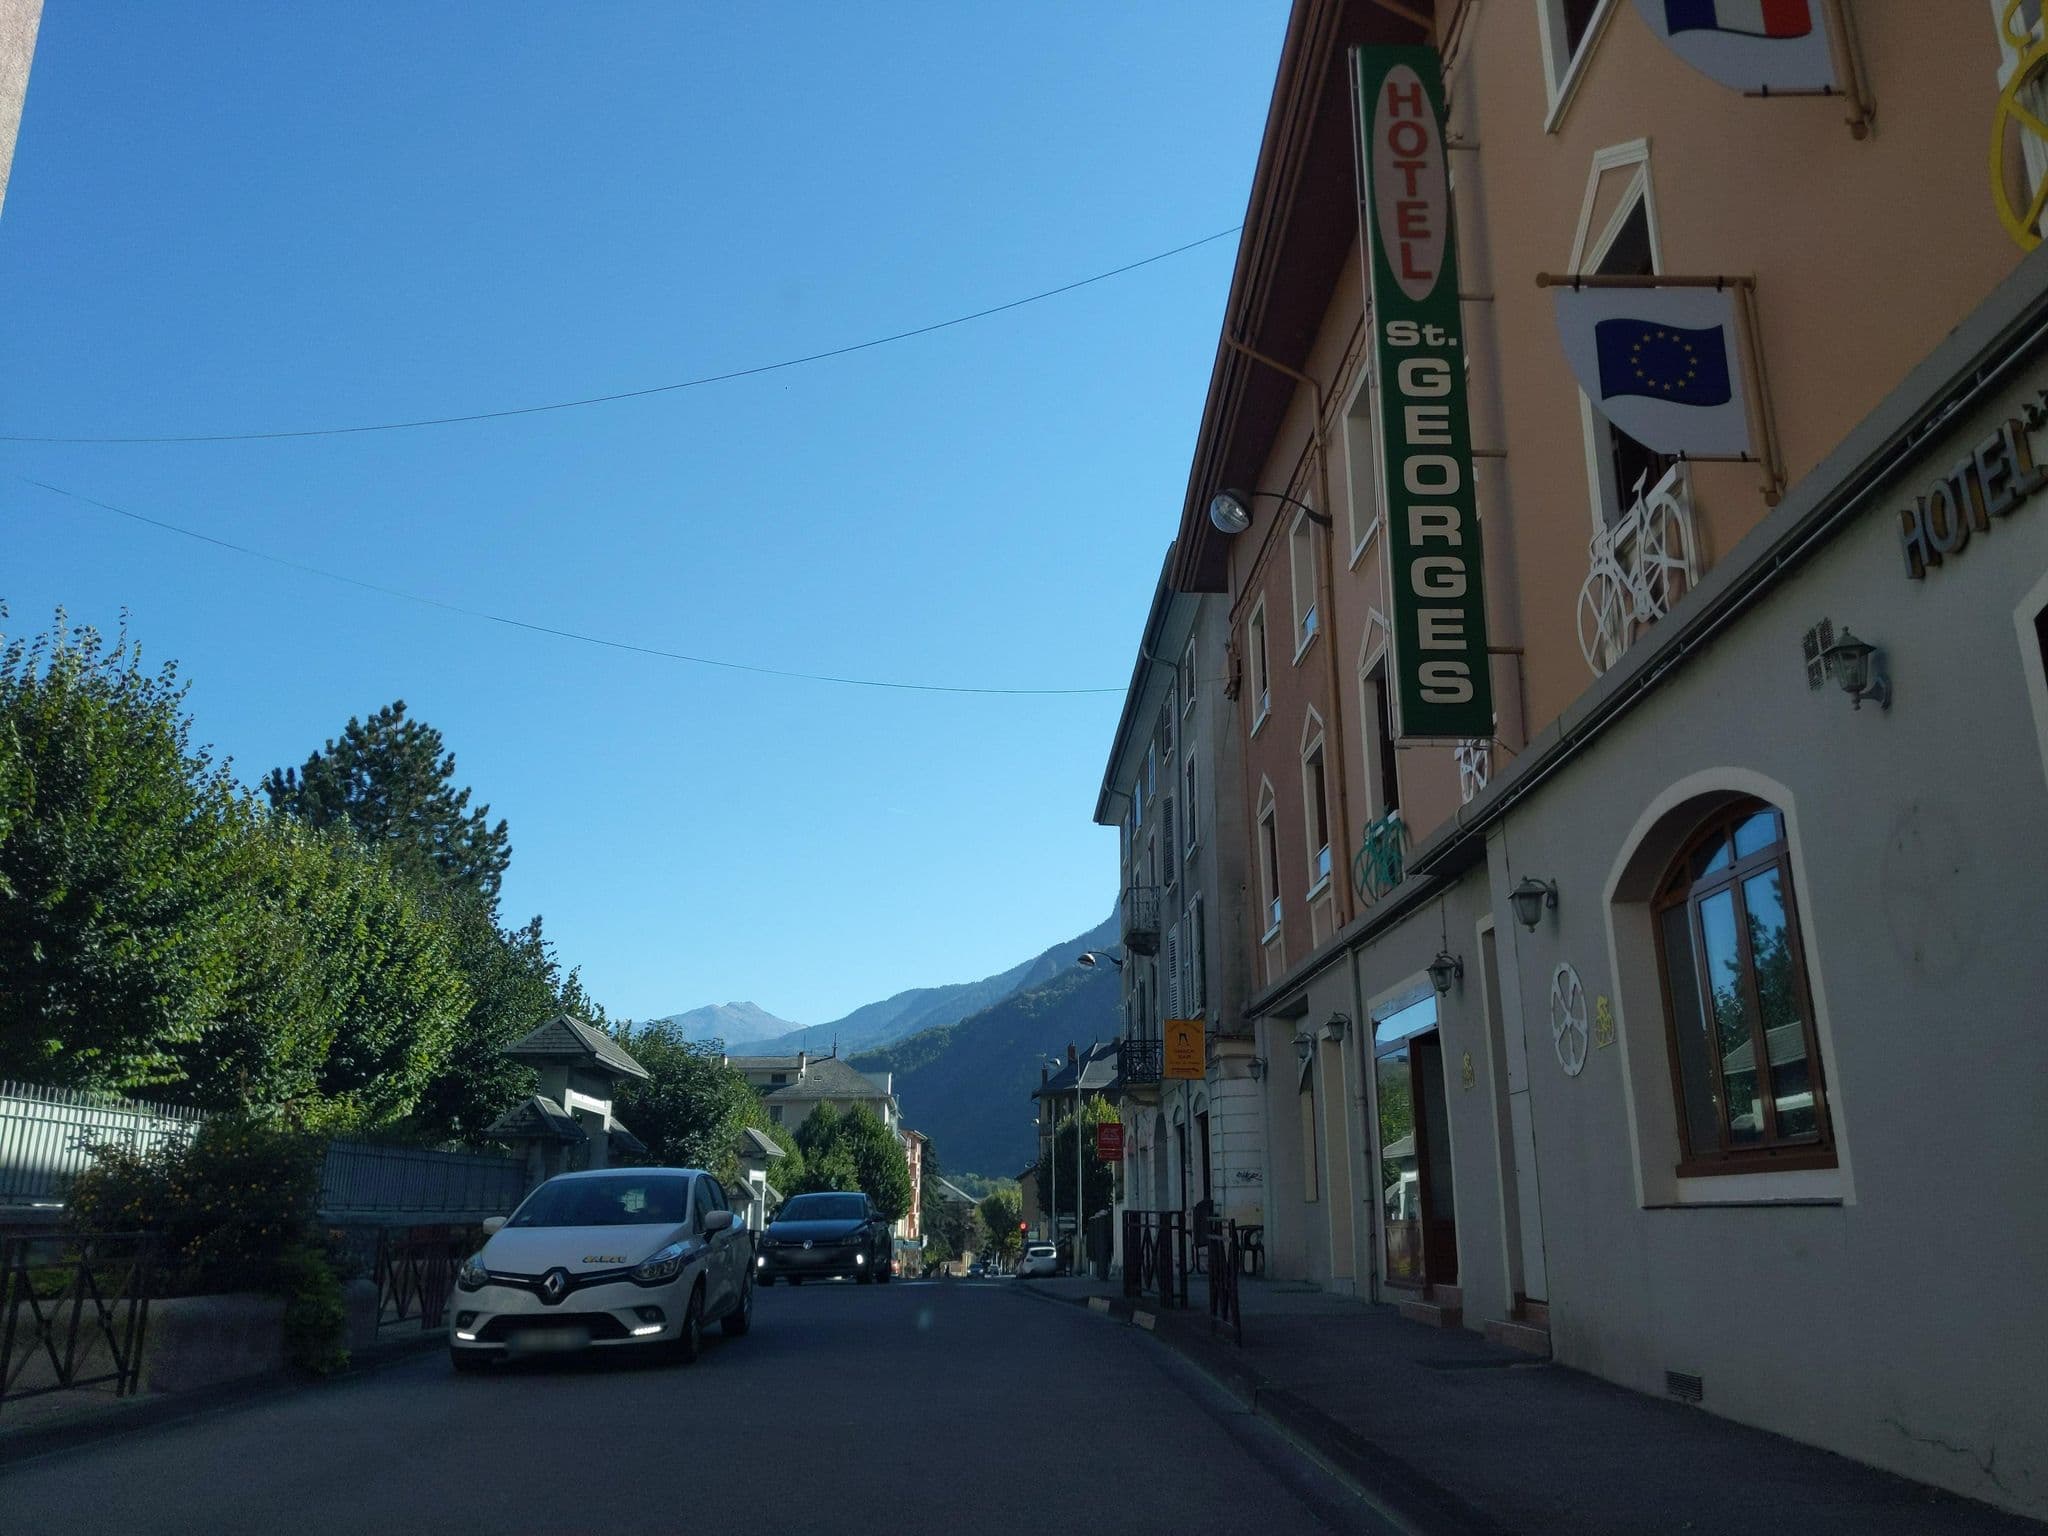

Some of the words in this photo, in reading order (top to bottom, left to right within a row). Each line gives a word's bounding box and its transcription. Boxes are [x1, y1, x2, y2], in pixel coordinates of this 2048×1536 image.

[1386, 82, 1433, 280] HOTEL
[1385, 319, 1458, 347] St.
[1397, 357, 1475, 704] GEORGES
[1896, 418, 2048, 580] HOTEL
